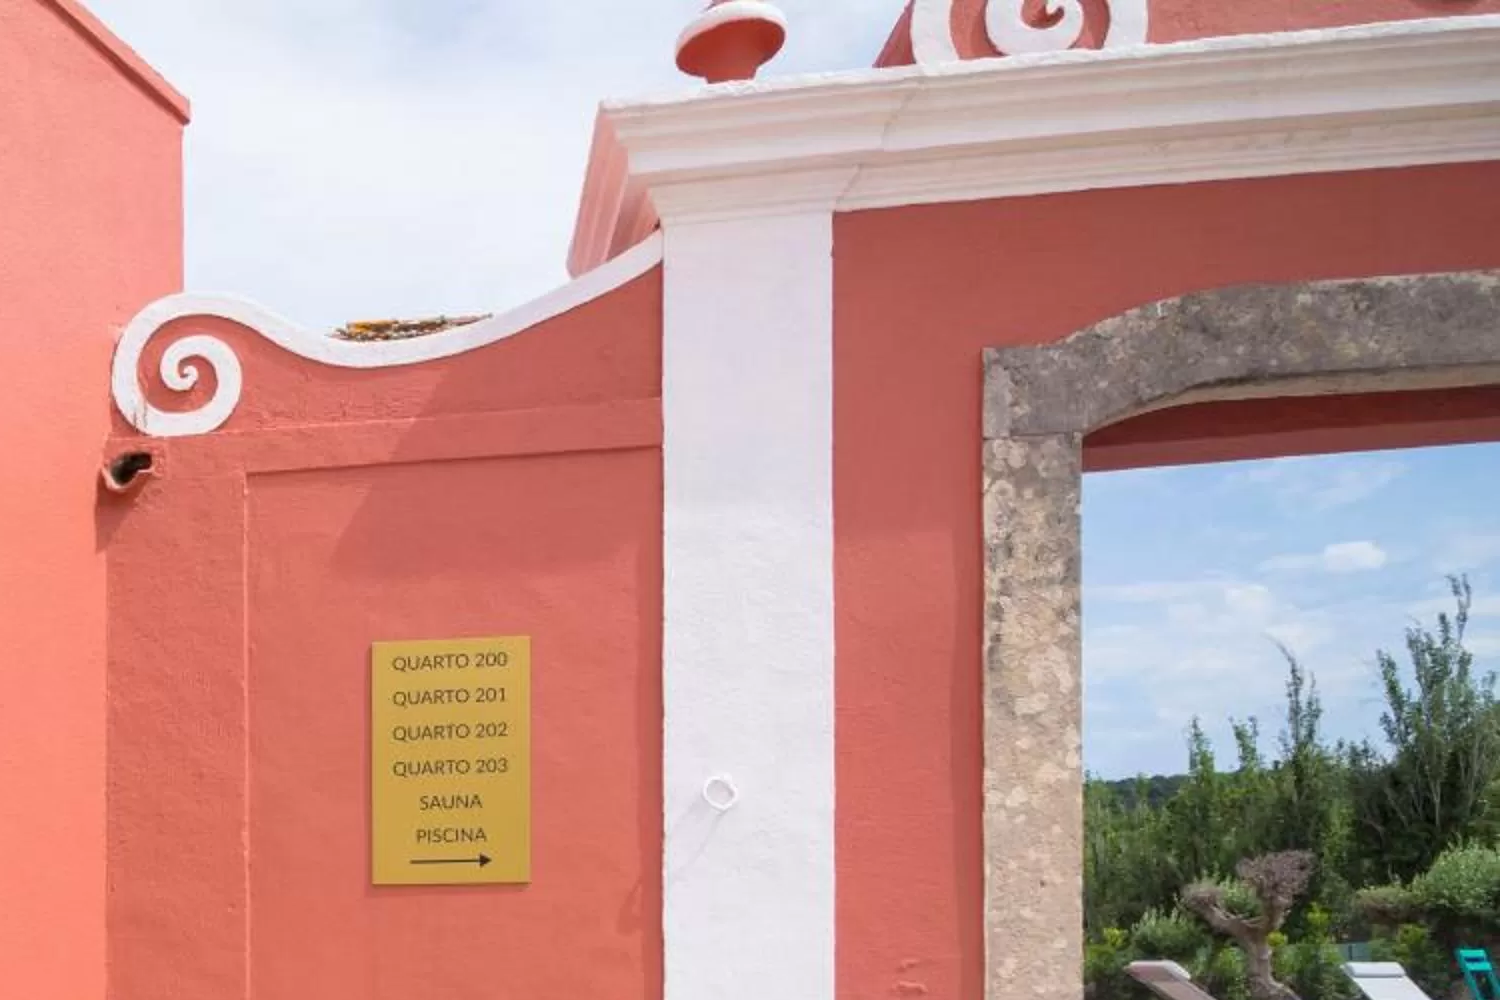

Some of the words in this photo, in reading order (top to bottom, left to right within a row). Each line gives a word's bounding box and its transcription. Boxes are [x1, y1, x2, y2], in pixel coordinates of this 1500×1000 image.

[392, 654, 469, 671] QUARTO
[475, 652, 507, 667] 200
[393, 689, 470, 707] QUARTO
[475, 687, 506, 703] 201
[393, 724, 470, 742] QUARTO
[476, 722, 508, 738] 202
[393, 759, 470, 777] QUARTO
[476, 758, 508, 773] 203
[419, 794, 483, 811] SAUNA
[416, 827, 487, 844] PISCINA
